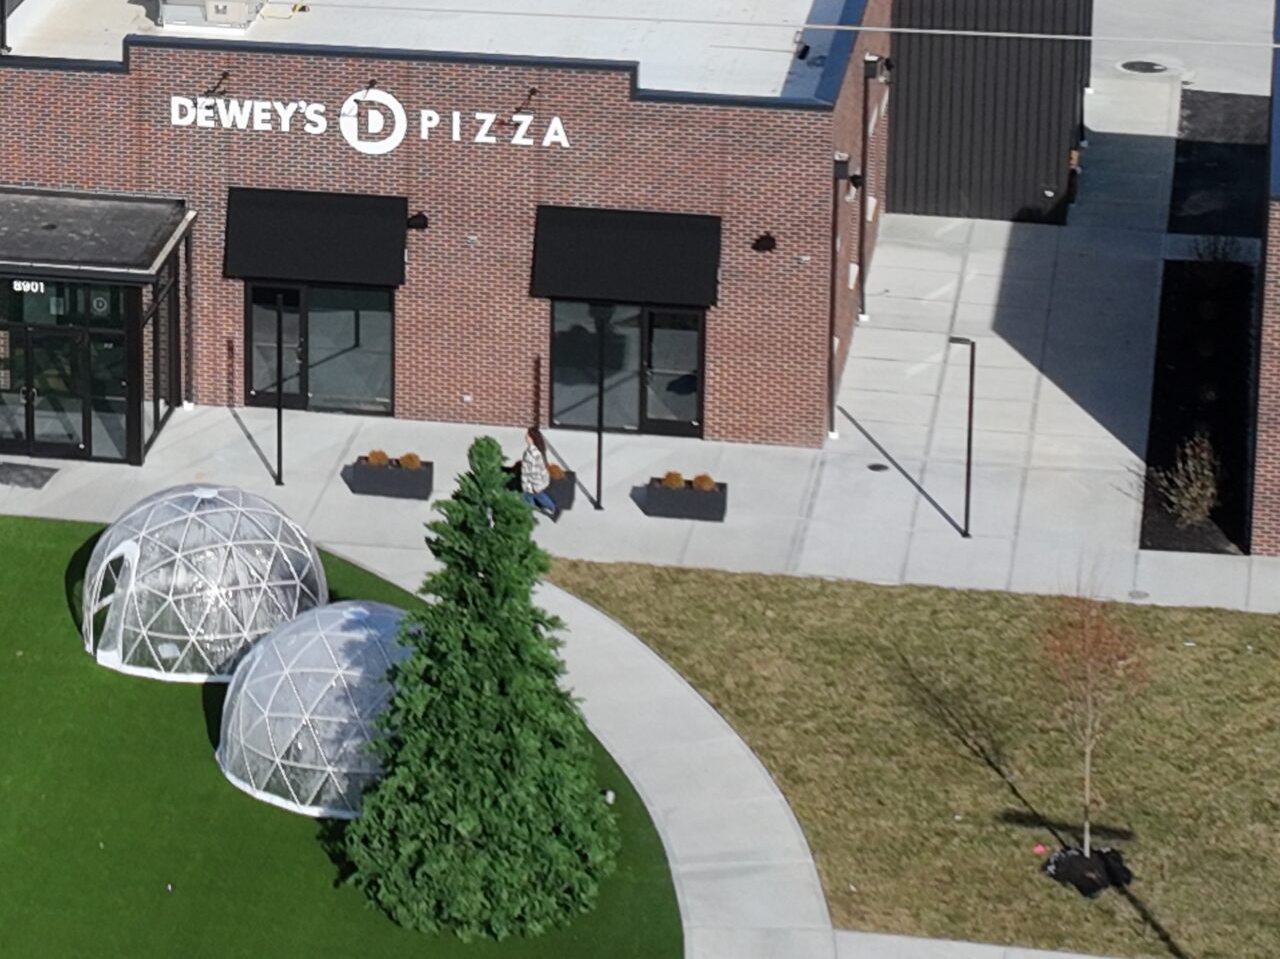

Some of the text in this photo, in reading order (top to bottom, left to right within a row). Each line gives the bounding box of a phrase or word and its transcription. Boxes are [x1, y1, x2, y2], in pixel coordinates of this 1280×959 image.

[170, 96, 328, 135] DEWEY'S
[420, 109, 571, 148] PIZZA
[12, 280, 46, 294] 8901
